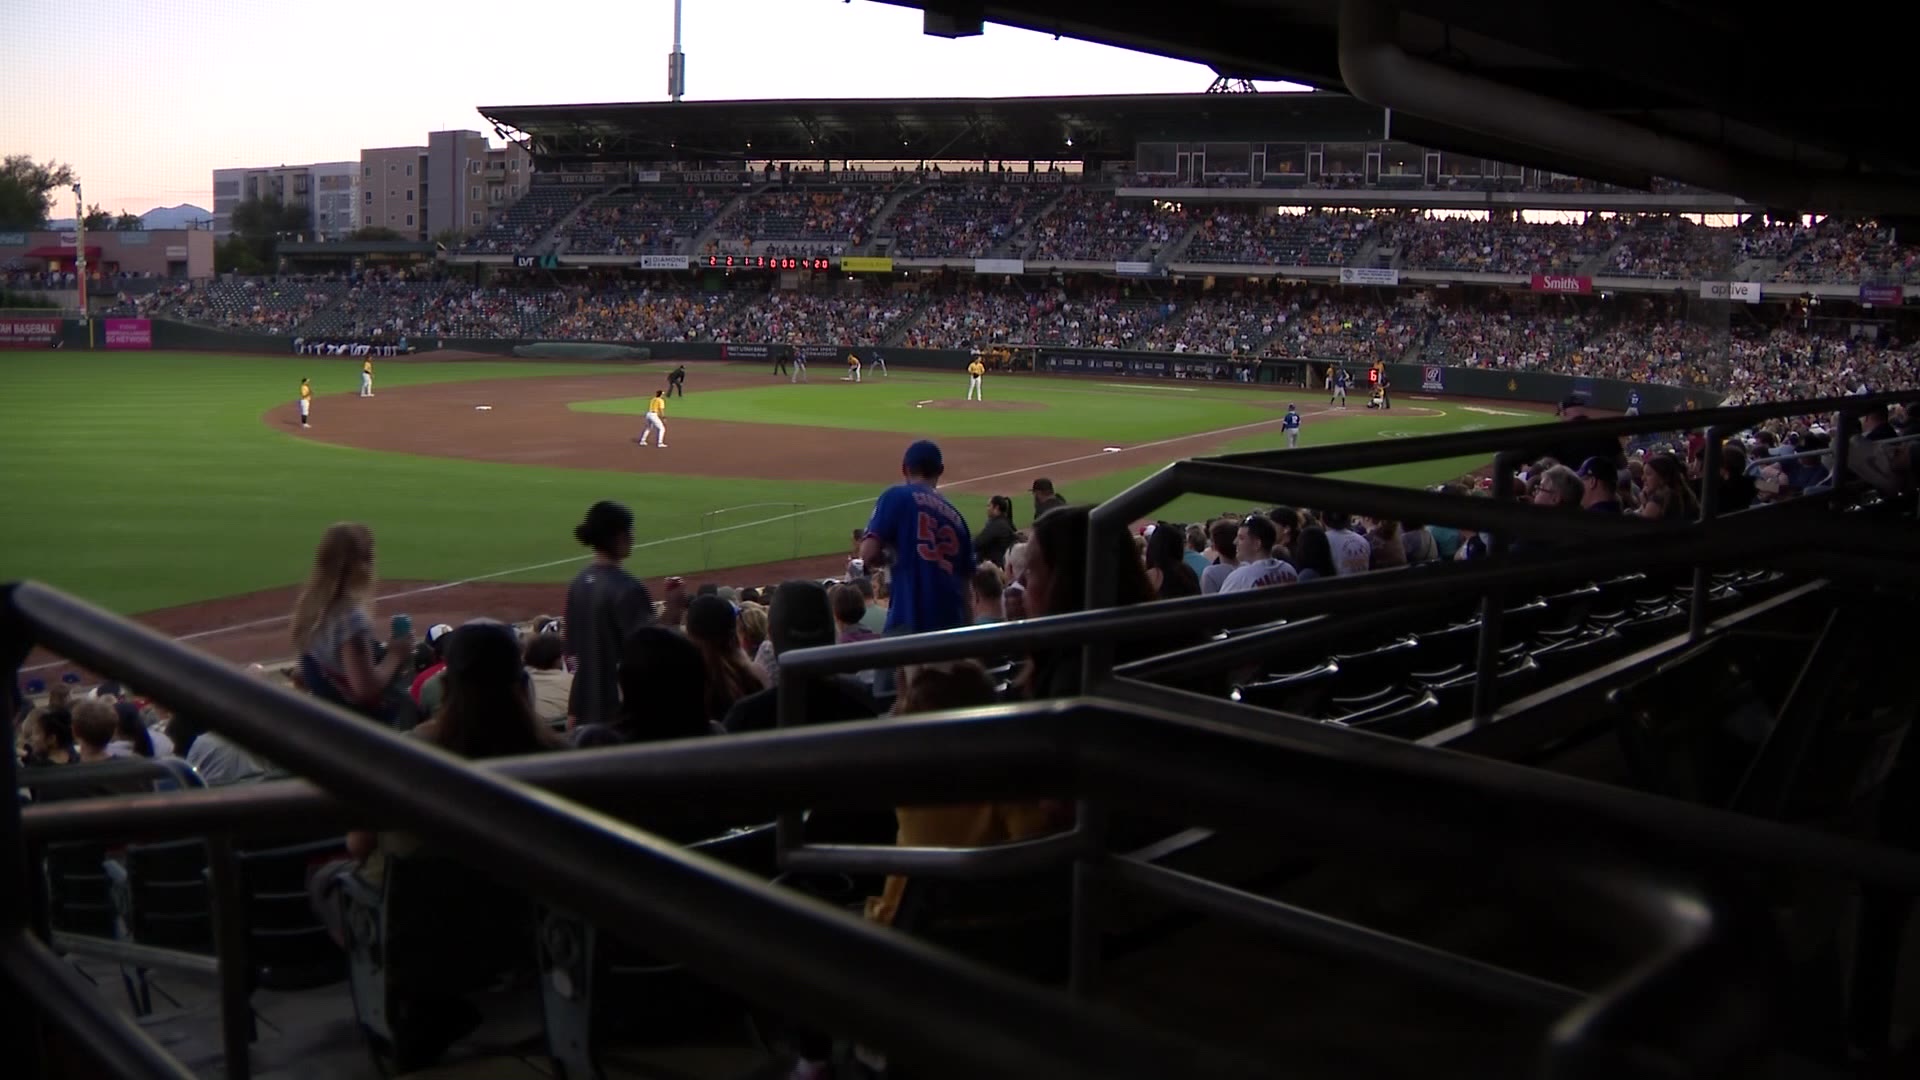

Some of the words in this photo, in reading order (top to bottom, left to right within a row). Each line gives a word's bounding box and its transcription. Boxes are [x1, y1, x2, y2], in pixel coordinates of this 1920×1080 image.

[683, 173, 712, 182] VISTA
[713, 173, 739, 182] DECK
[836, 172, 866, 182] VISTA
[868, 172, 895, 182] DECK
[1004, 173, 1035, 183] VISTA
[1037, 174, 1063, 183] DECK
[518, 257, 535, 267] LVT
[710, 256, 717, 266] 2
[727, 256, 733, 266] 2
[1543, 275, 1580, 290] Smith's
[14, 323, 57, 334] BASEBALL
[1370, 369, 1377, 382] 6
[917, 511, 959, 575] 52
